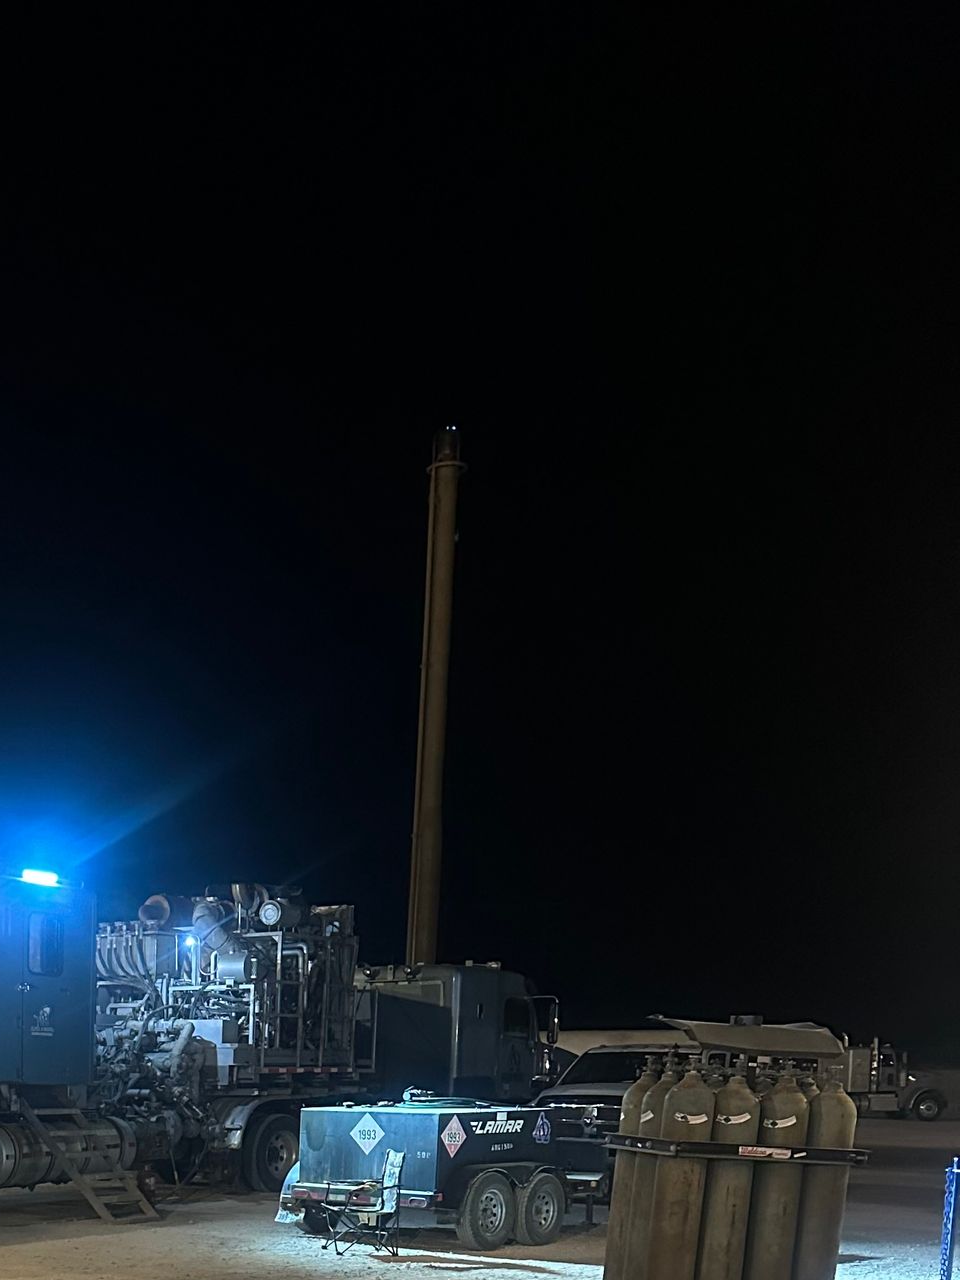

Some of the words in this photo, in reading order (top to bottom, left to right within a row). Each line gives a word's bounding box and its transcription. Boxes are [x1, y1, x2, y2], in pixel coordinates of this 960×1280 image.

[474, 1120, 524, 1134] LAMAR
[358, 1129, 377, 1140] 1993
[447, 1131, 461, 1143] 1993
